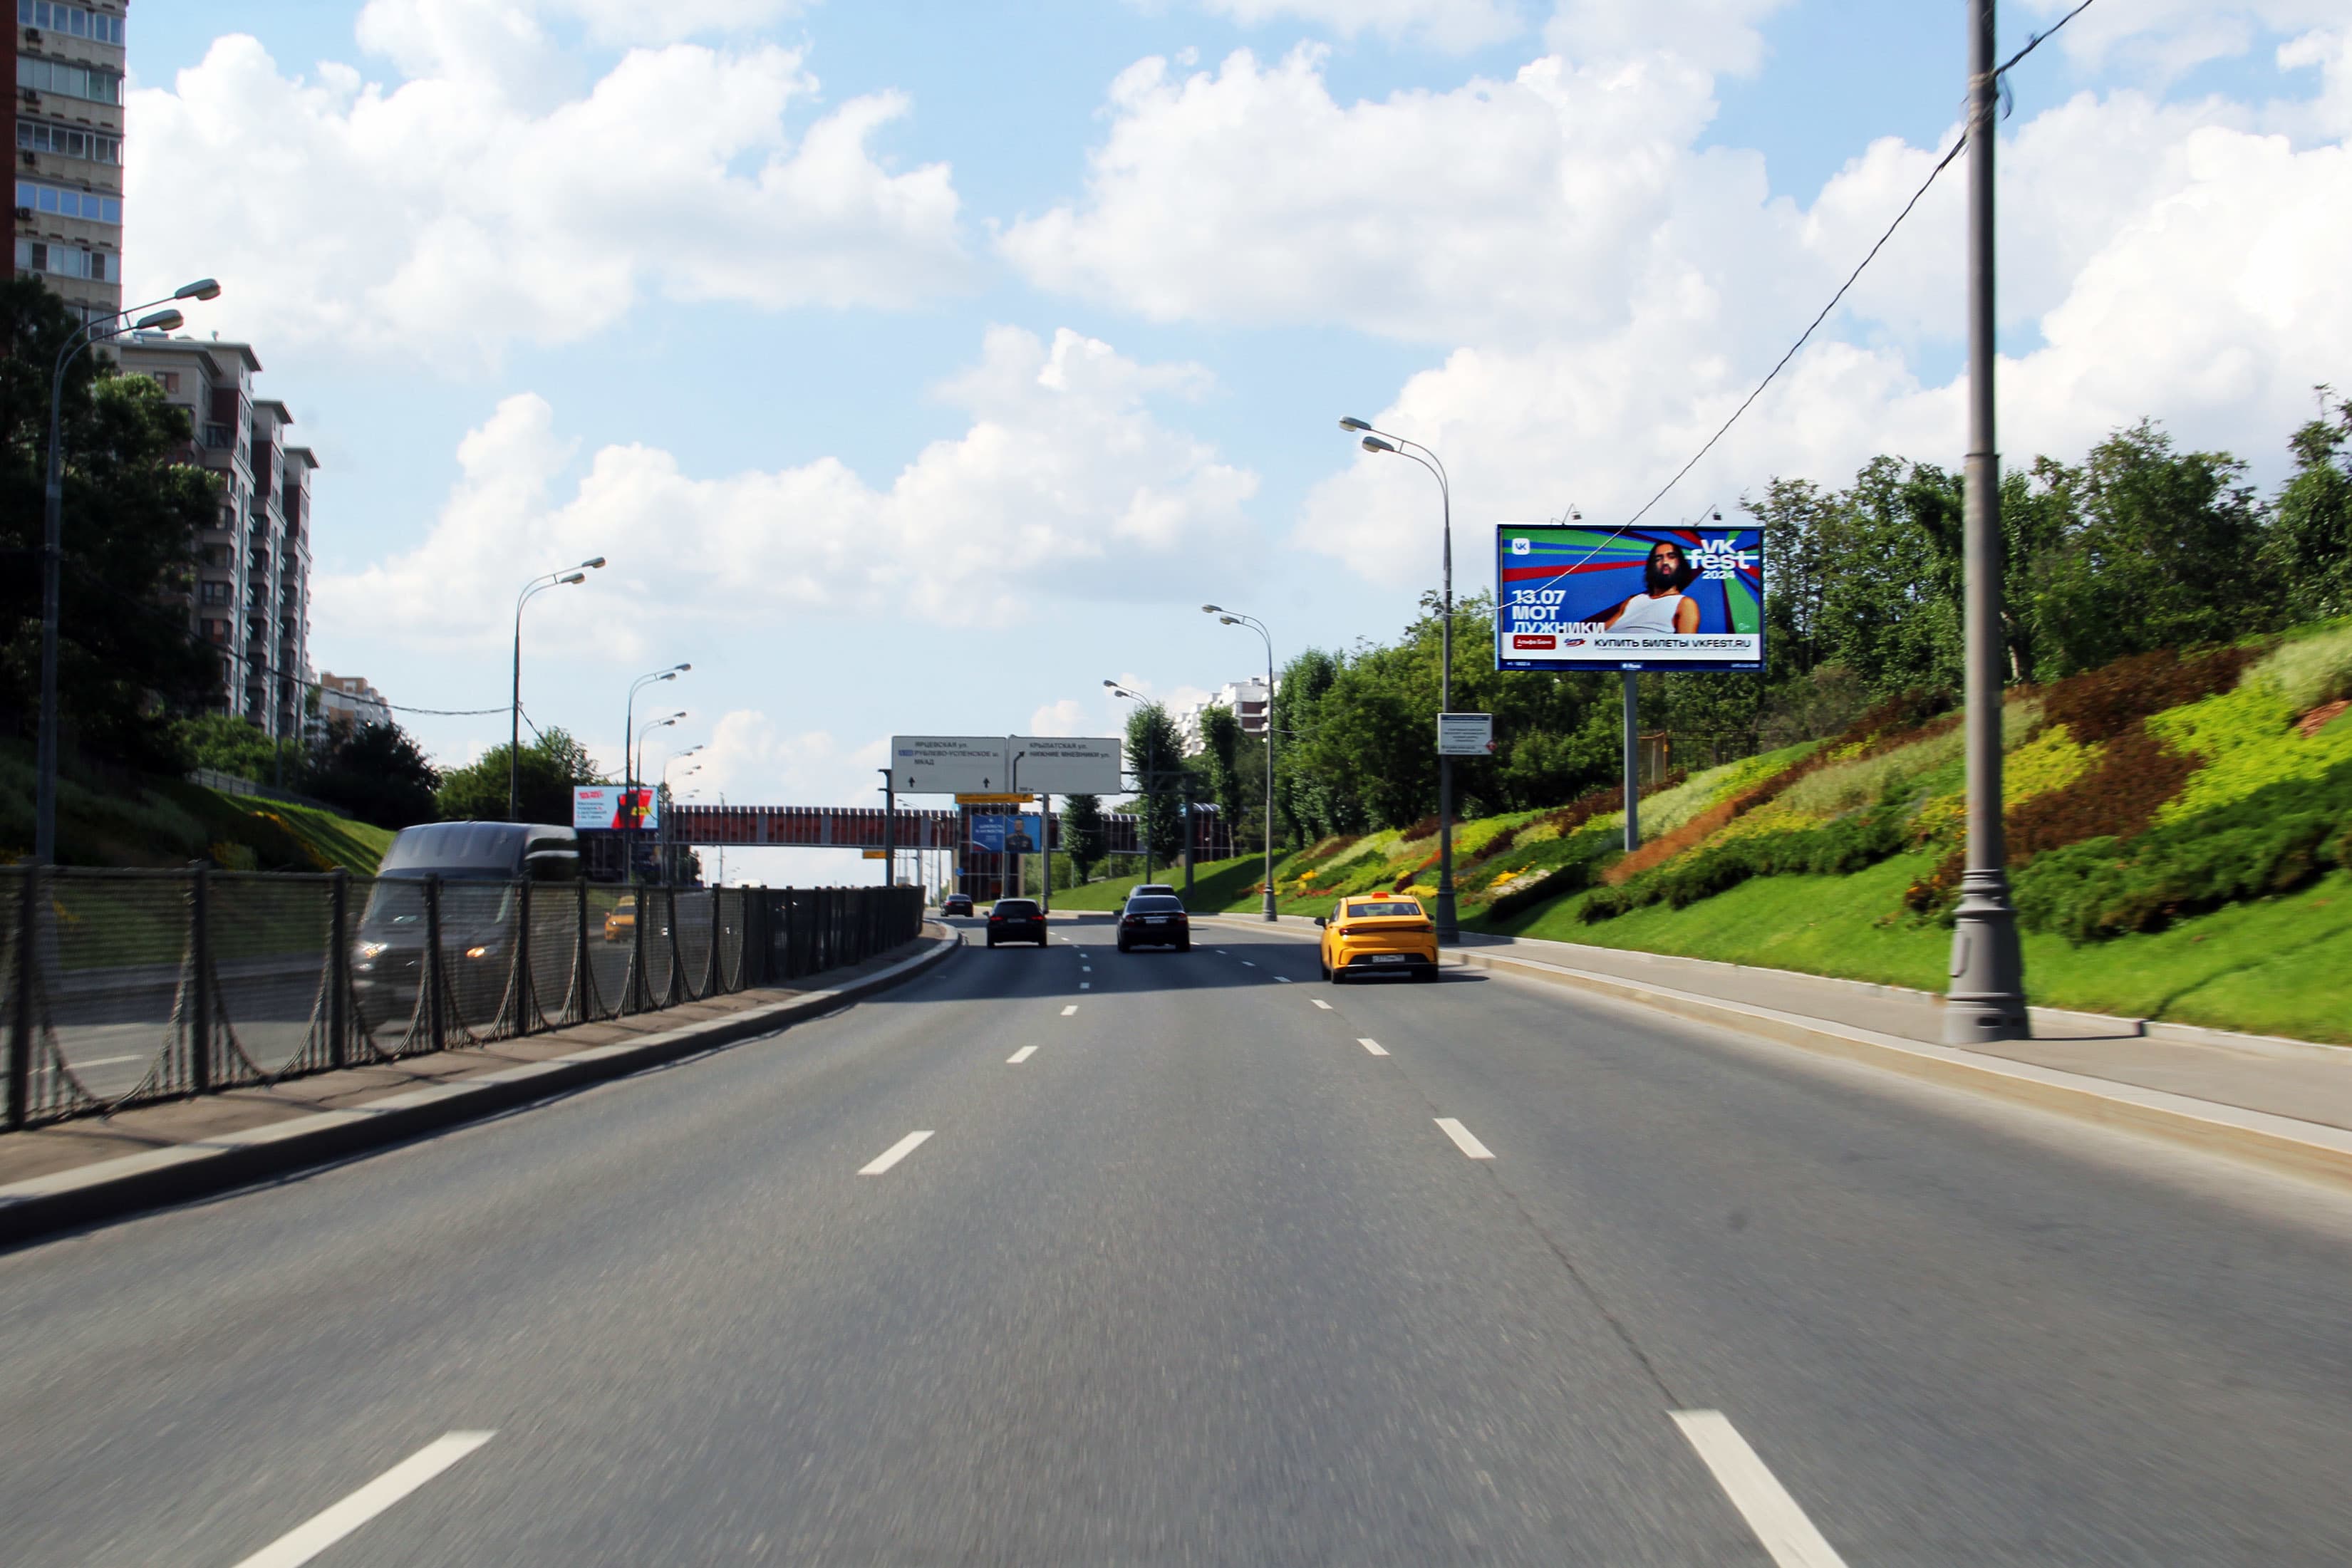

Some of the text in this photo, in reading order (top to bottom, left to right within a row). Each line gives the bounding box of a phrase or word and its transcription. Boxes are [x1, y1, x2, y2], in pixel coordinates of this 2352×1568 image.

[1701, 539, 1736, 554] VK
[1684, 548, 1759, 569] fest
[1702, 571, 1736, 579] 2024
[1512, 589, 1567, 604] 13.07
[1512, 606, 1560, 620] МОТ
[1512, 622, 1605, 633] ЛУЖНИКИ
